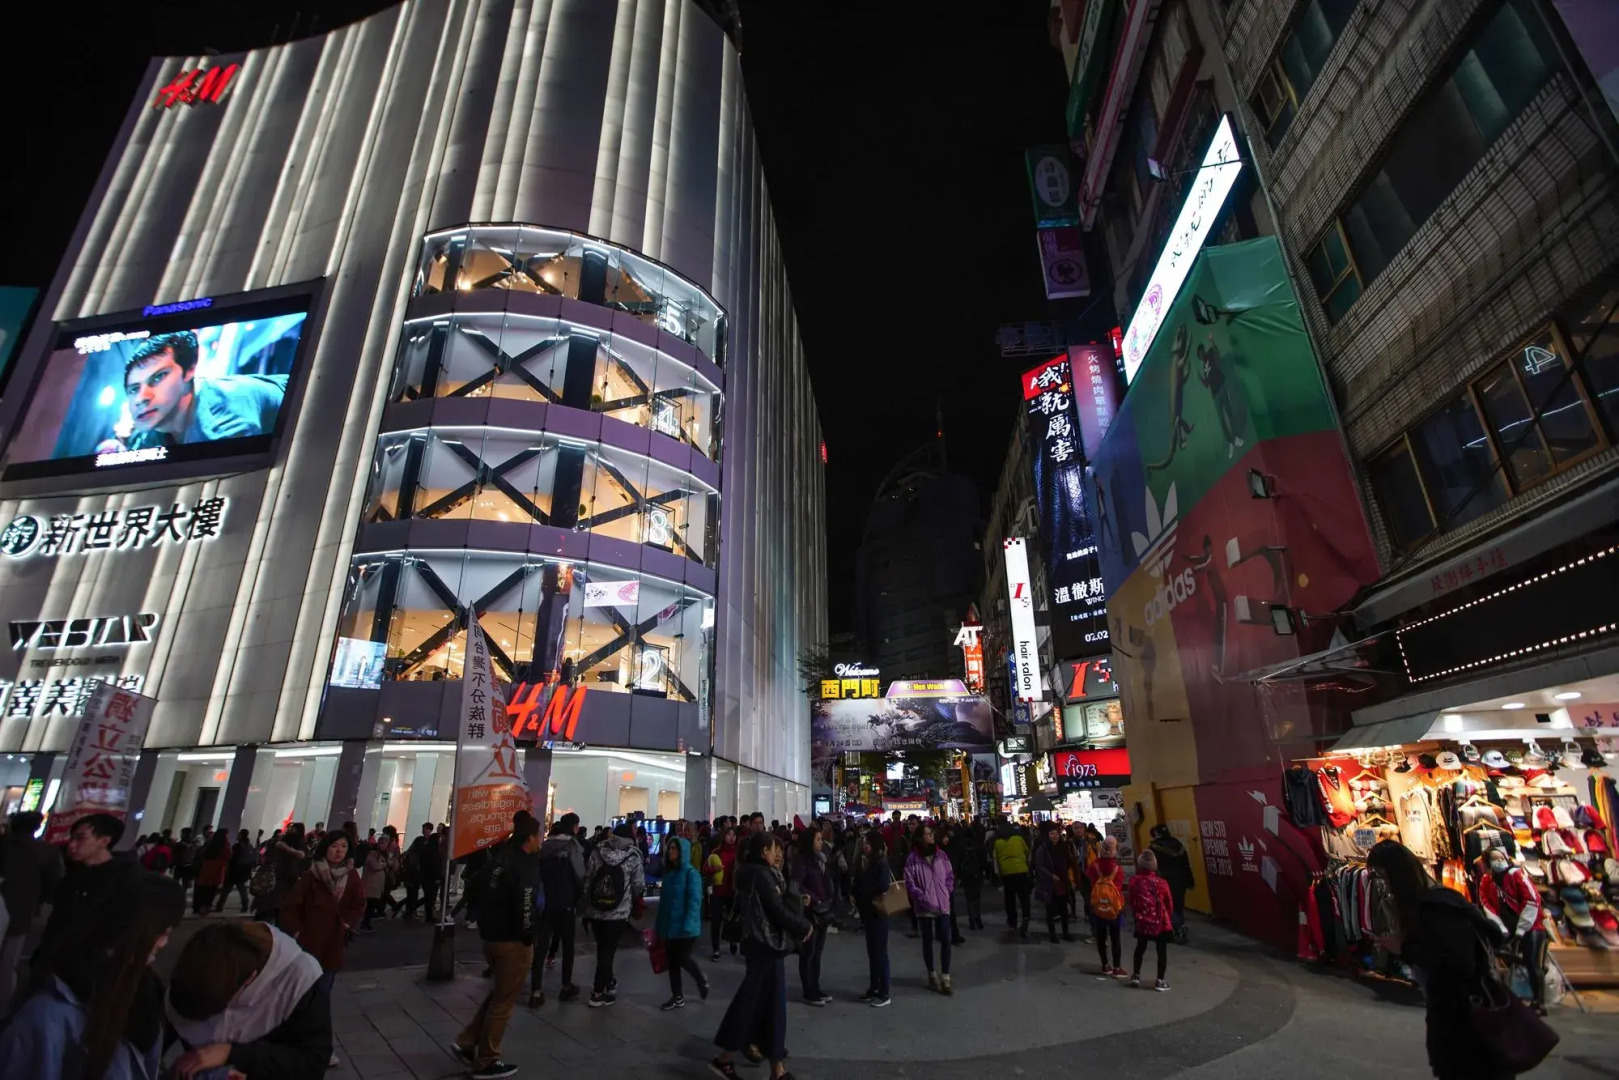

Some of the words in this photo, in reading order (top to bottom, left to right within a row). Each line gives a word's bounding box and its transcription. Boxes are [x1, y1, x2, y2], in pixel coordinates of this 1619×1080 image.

[142, 297, 213, 317] Panasonic
[40, 497, 226, 554] 新世界大樓
[1054, 577, 1105, 604] 溫徹斯
[1145, 567, 1195, 626] adidas
[1020, 640, 1031, 659] hair
[637, 651, 661, 689] 2
[834, 662, 880, 677] Welcome
[1022, 662, 1033, 690] salon
[821, 679, 880, 699] 西門町
[506, 681, 588, 741] H&M
[1200, 820, 1214, 837] NEW
[1203, 838, 1229, 857] OPENING
